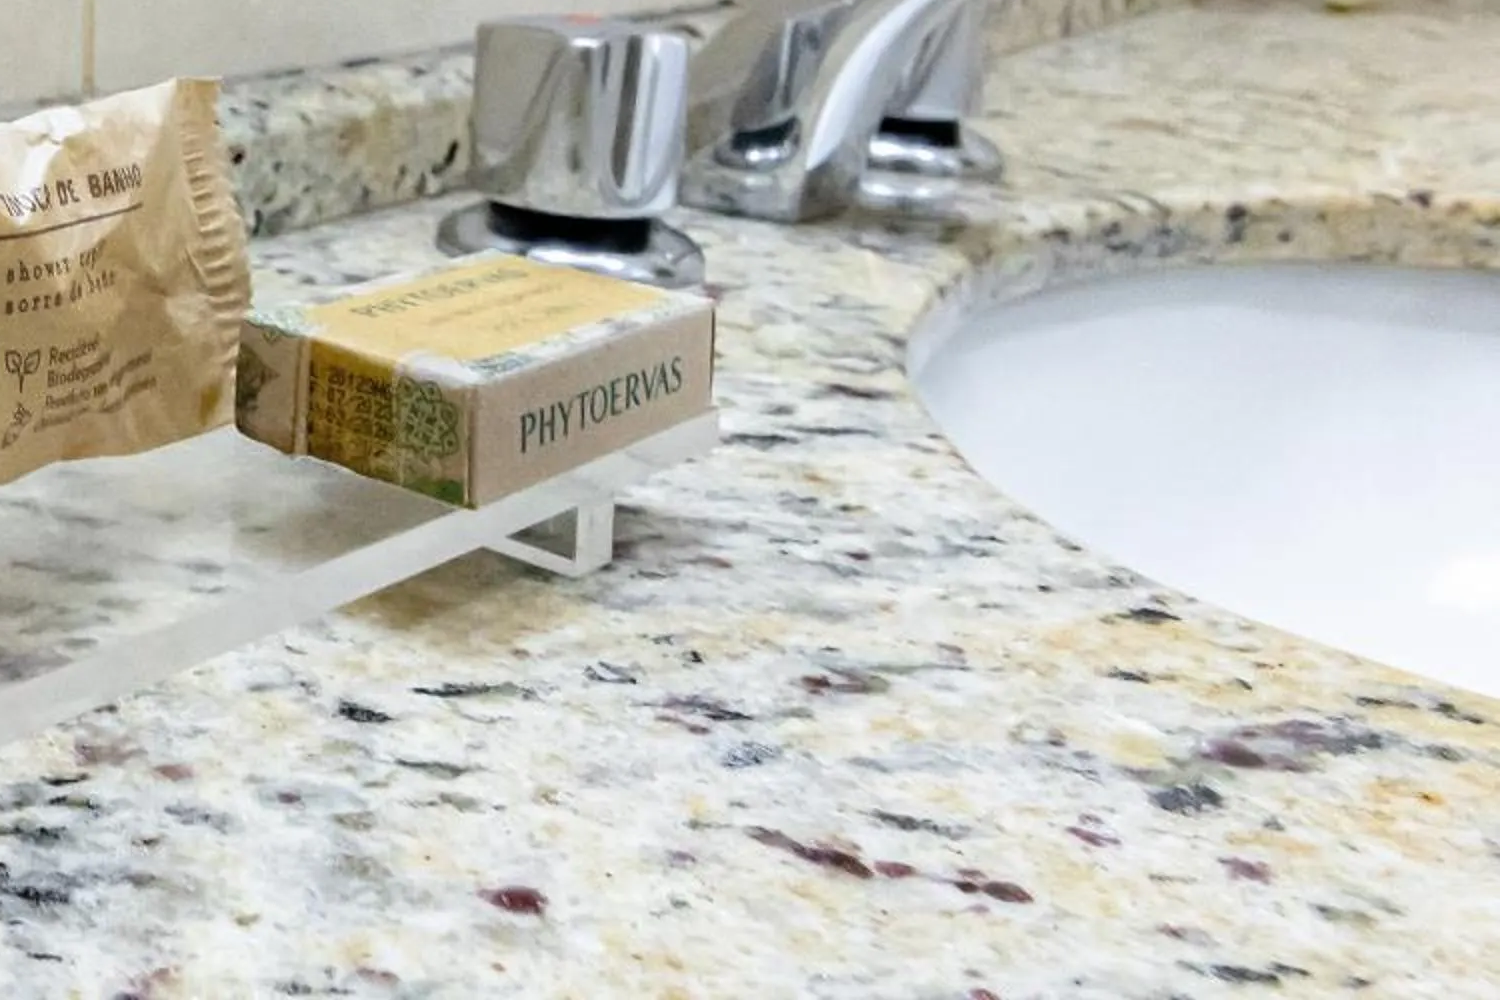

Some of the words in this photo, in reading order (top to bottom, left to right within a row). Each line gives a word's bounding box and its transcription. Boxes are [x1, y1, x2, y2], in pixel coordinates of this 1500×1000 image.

[56, 179, 80, 206] DE
[87, 163, 142, 198] BANHO
[519, 355, 683, 454] PHYTOERVAS
